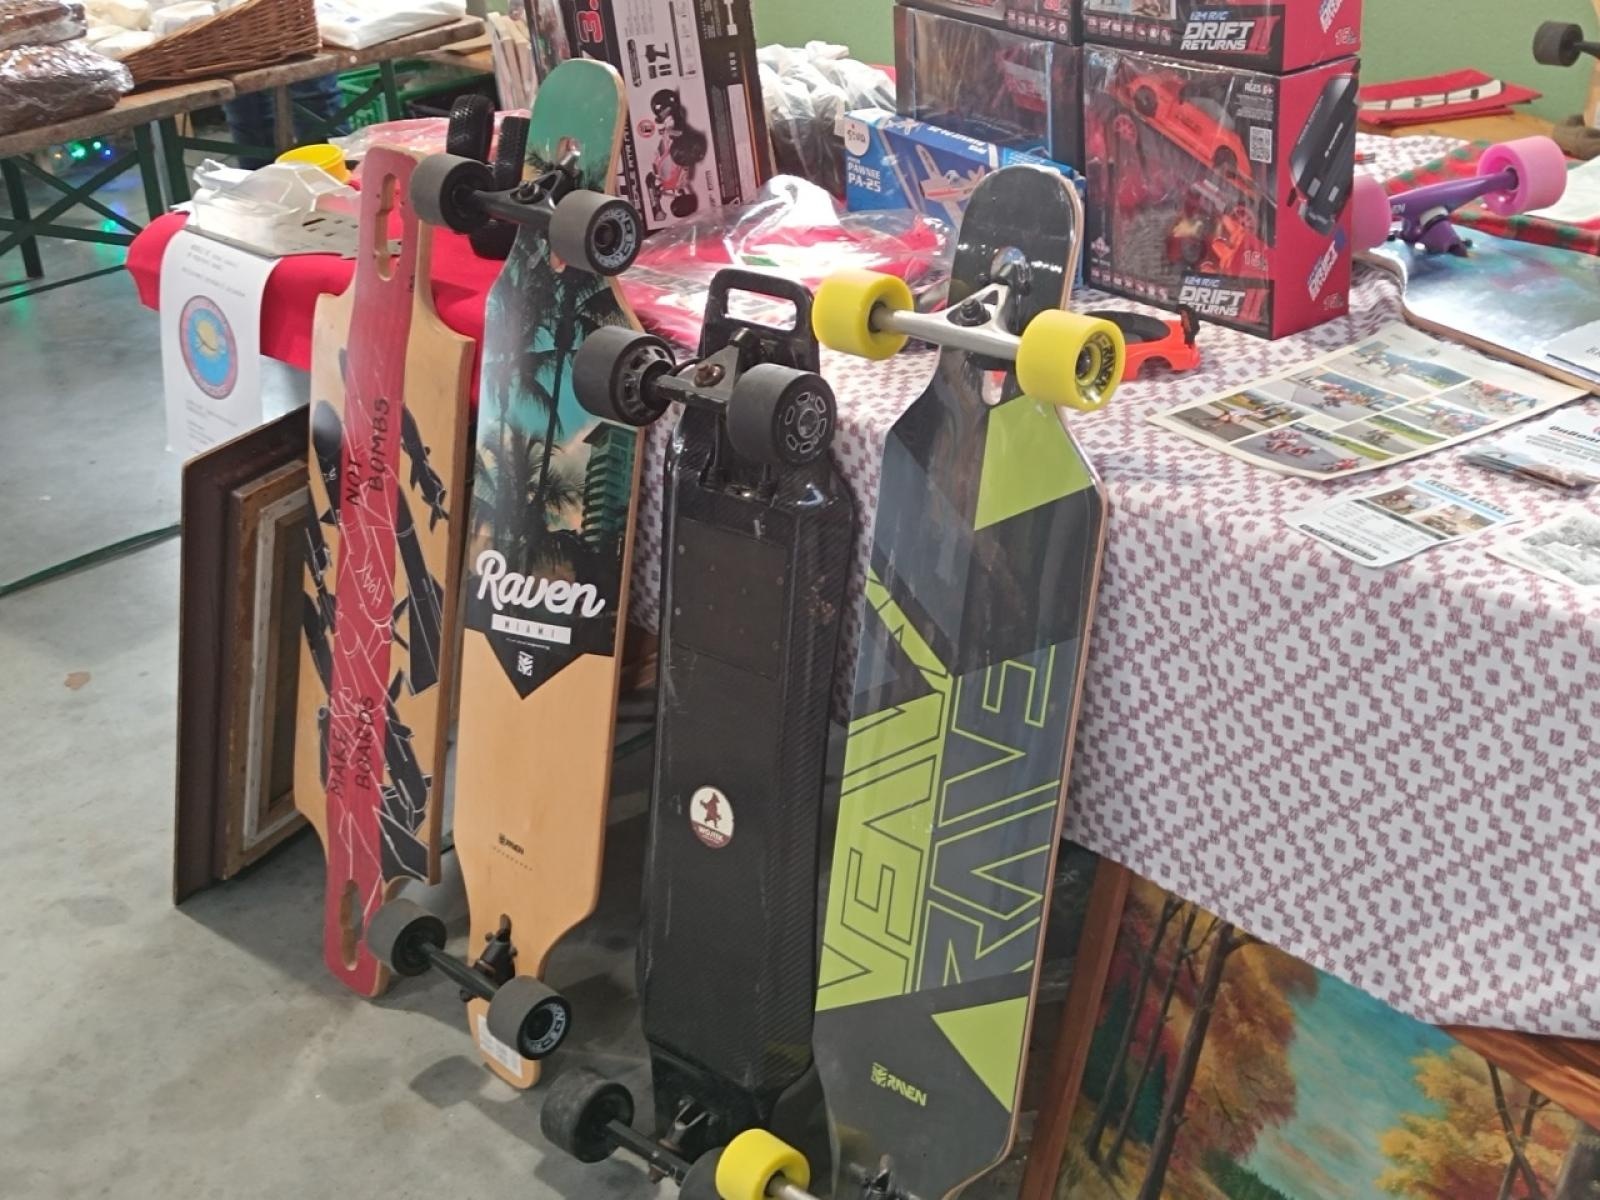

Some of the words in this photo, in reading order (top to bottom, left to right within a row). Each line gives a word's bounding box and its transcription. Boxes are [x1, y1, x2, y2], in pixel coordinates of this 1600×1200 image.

[1180, 40, 1246, 51] RETURNS
[1182, 22, 1255, 40] DRIFT
[848, 172, 881, 192] PA-25
[1178, 285, 1246, 307] DRIFT
[368, 397, 390, 492] BOMBS
[345, 459, 363, 506] NOT
[476, 550, 606, 618] Raven
[329, 730, 348, 797] MAKE
[887, 1073, 928, 1107] RAVEN
